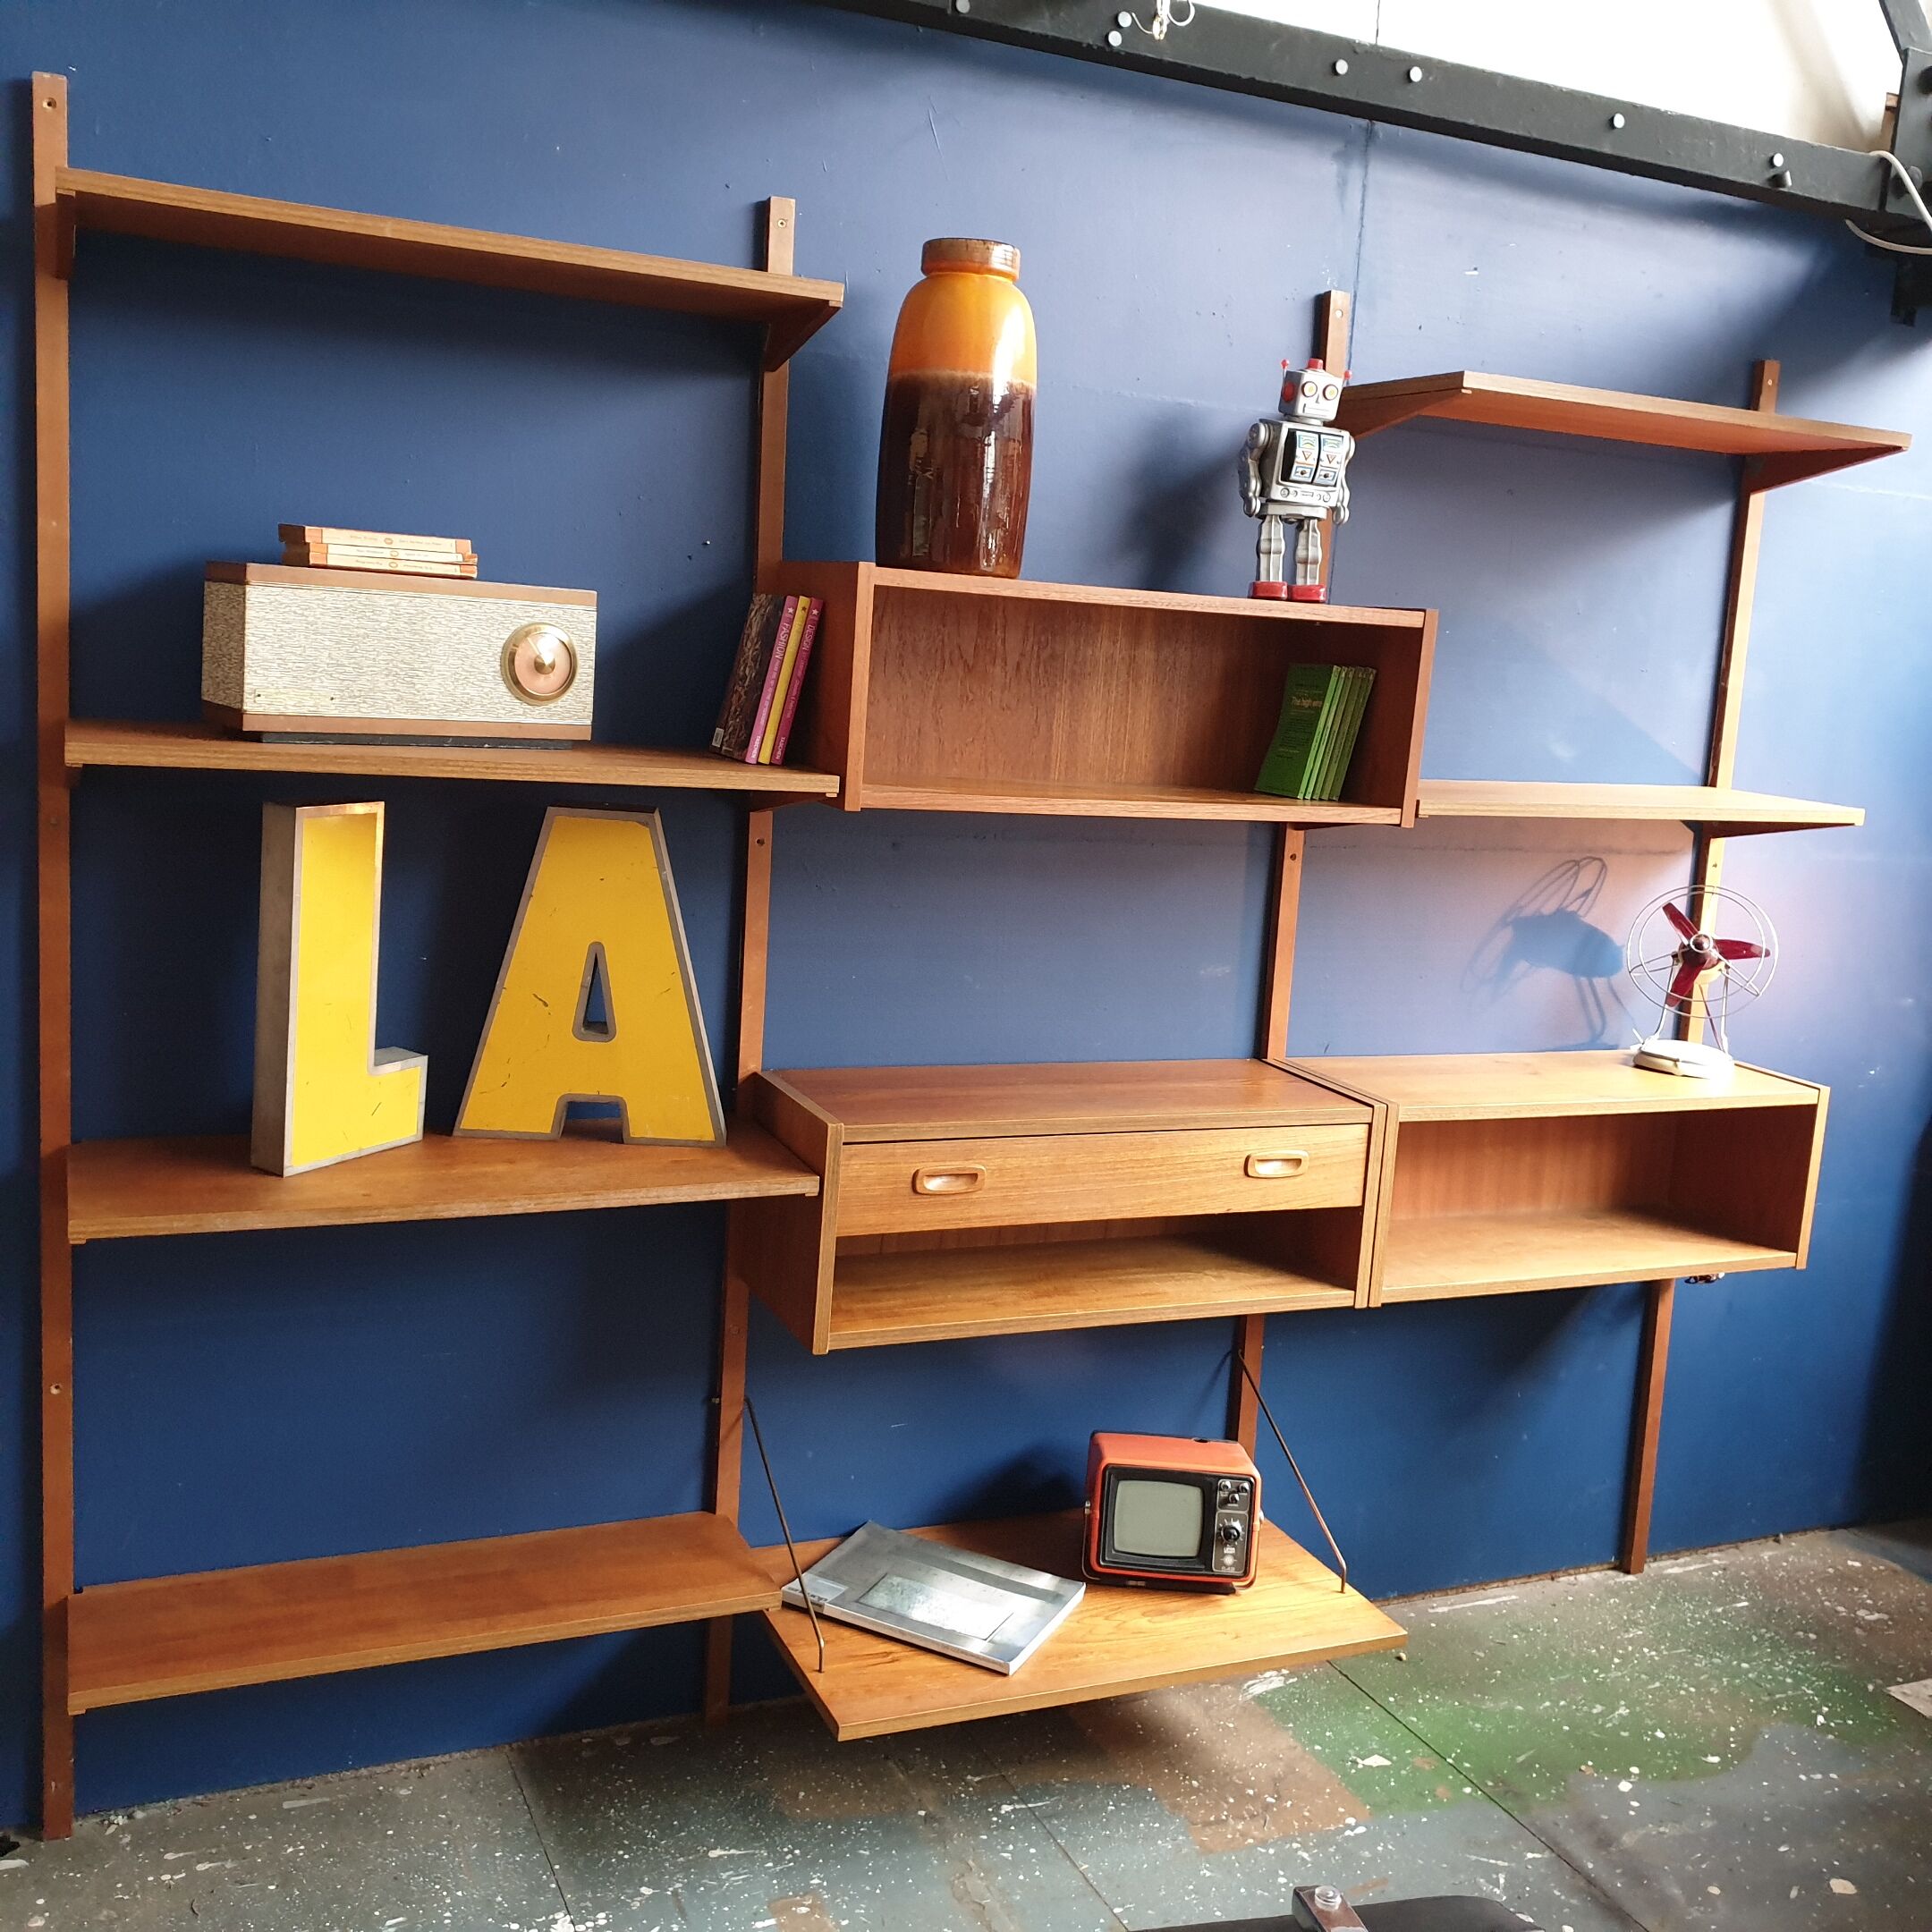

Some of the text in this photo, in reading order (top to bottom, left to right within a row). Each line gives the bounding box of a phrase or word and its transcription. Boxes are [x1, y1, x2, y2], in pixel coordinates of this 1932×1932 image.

[774, 623, 791, 659] FASHION
[802, 623, 817, 650] DESIGN
[750, 735, 761, 758] TASCHEN
[775, 736, 786, 759] TASCHEN
[251, 801, 726, 1177] LA
